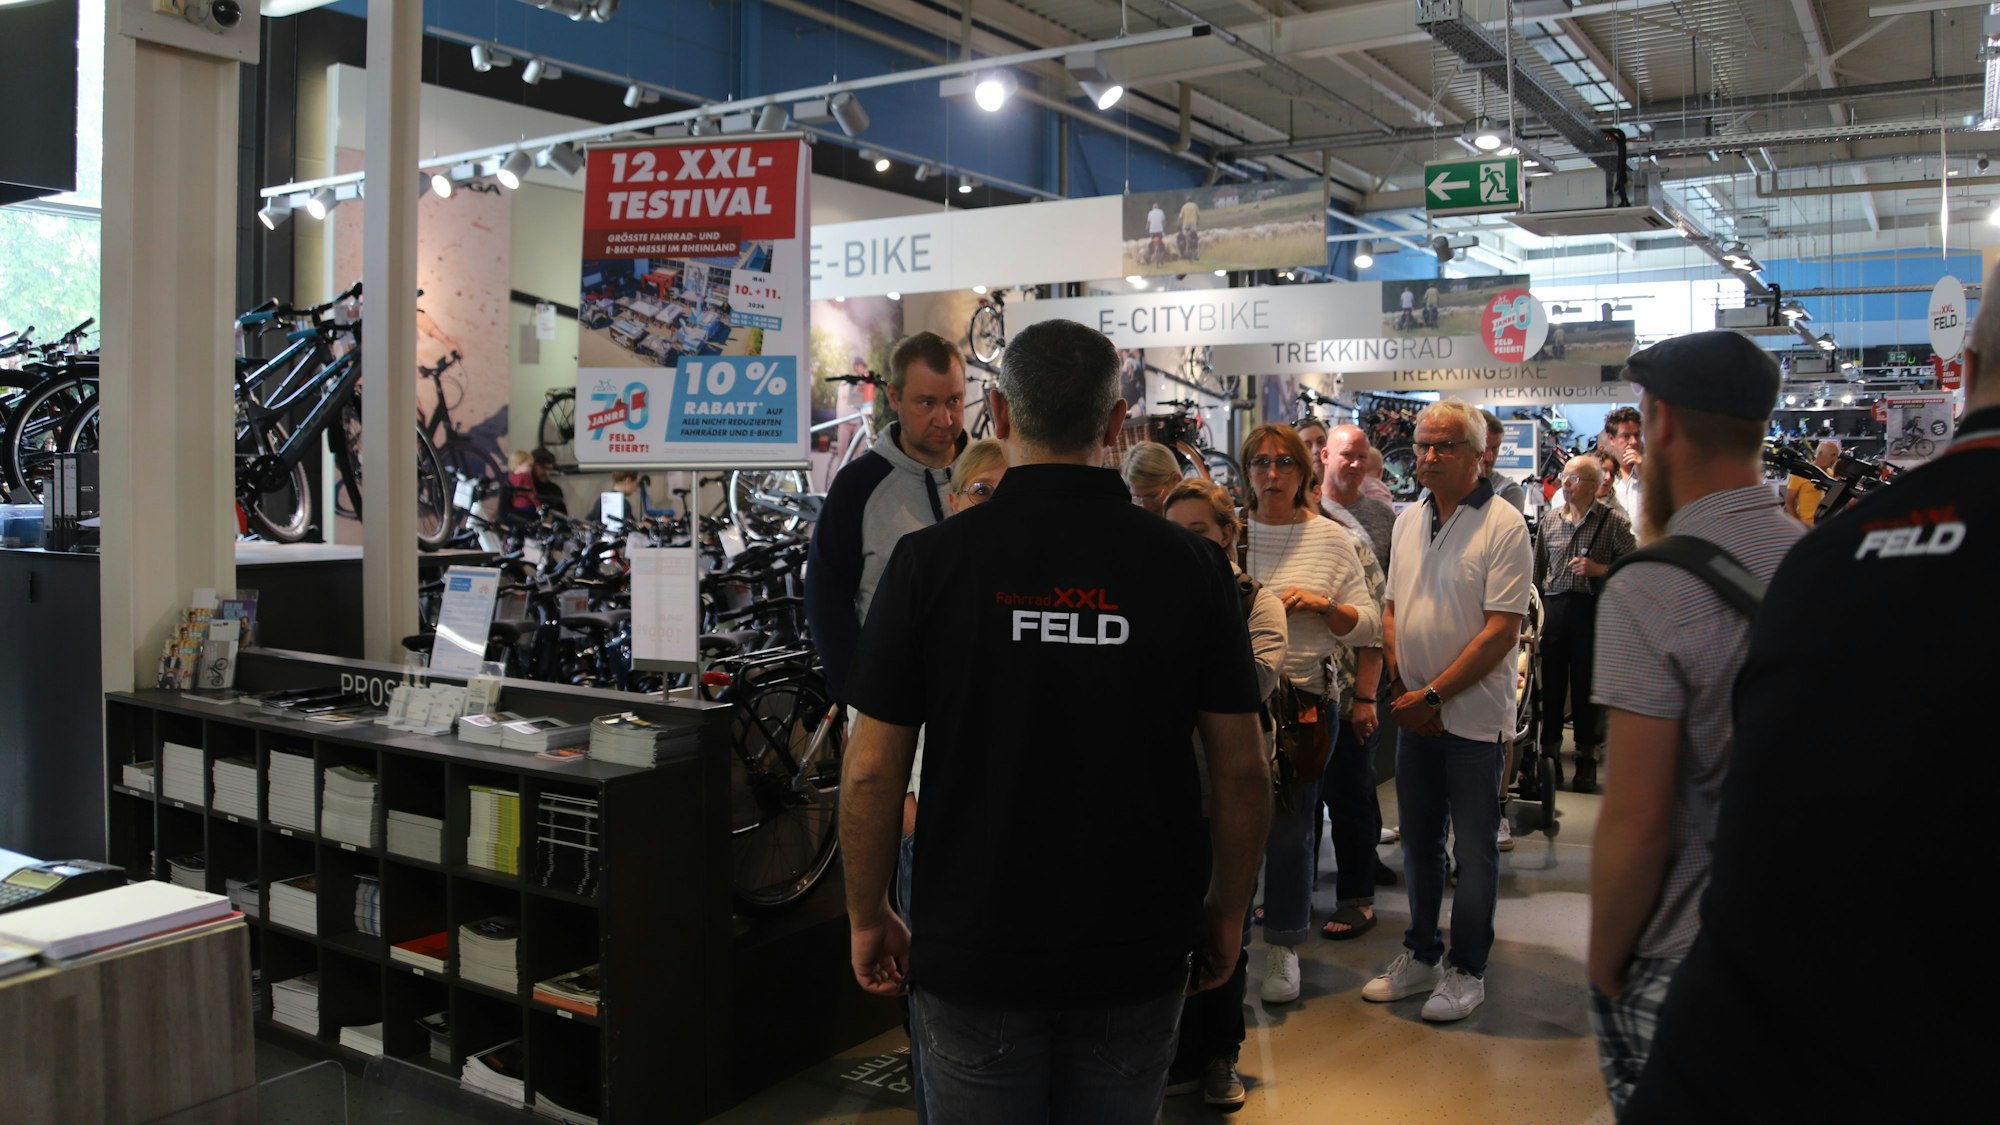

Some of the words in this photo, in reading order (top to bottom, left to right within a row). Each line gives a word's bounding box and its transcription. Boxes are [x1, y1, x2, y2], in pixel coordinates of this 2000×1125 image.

[611, 151, 669, 184] 12.
[674, 147, 773, 181] XXL-
[607, 186, 772, 220] TESTIVAL
[607, 231, 649, 243] GRÖSSTE
[649, 232, 697, 242] FAHRRAD-
[698, 231, 720, 241] UND
[605, 244, 666, 255] E-BIKE-MESSE
[667, 244, 680, 253] IM
[681, 243, 737, 252] RHEINLAND
[735, 284, 753, 296] 10.
[765, 287, 782, 300] 11.
[748, 302, 765, 310] 2024
[1098, 300, 1271, 336] E-CITYBIKE
[1933, 314, 1958, 331] FELD
[1272, 336, 1453, 364] TREKKINGRAD
[1494, 338, 1514, 346] FELD
[1494, 345, 1524, 354] FEIERT!
[685, 361, 736, 396] 10
[745, 361, 788, 396] %
[590, 381, 649, 441] 70
[591, 409, 626, 427] JAHRE
[766, 408, 784, 416] AUF
[682, 418, 700, 427] ALLE
[701, 418, 727, 427] NICHT
[728, 418, 782, 427] REDUZIERTEN
[608, 433, 635, 442] FELD
[680, 427, 728, 437] FAHRRÄDER
[729, 428, 749, 437] UND
[750, 428, 783, 438] E-BIKES!
[608, 444, 649, 453] FEIERT!
[1854, 521, 1967, 561] FELD
[994, 591, 1051, 607] Fahrrad
[1053, 586, 1119, 611] XXL
[1012, 609, 1130, 646] FELD
